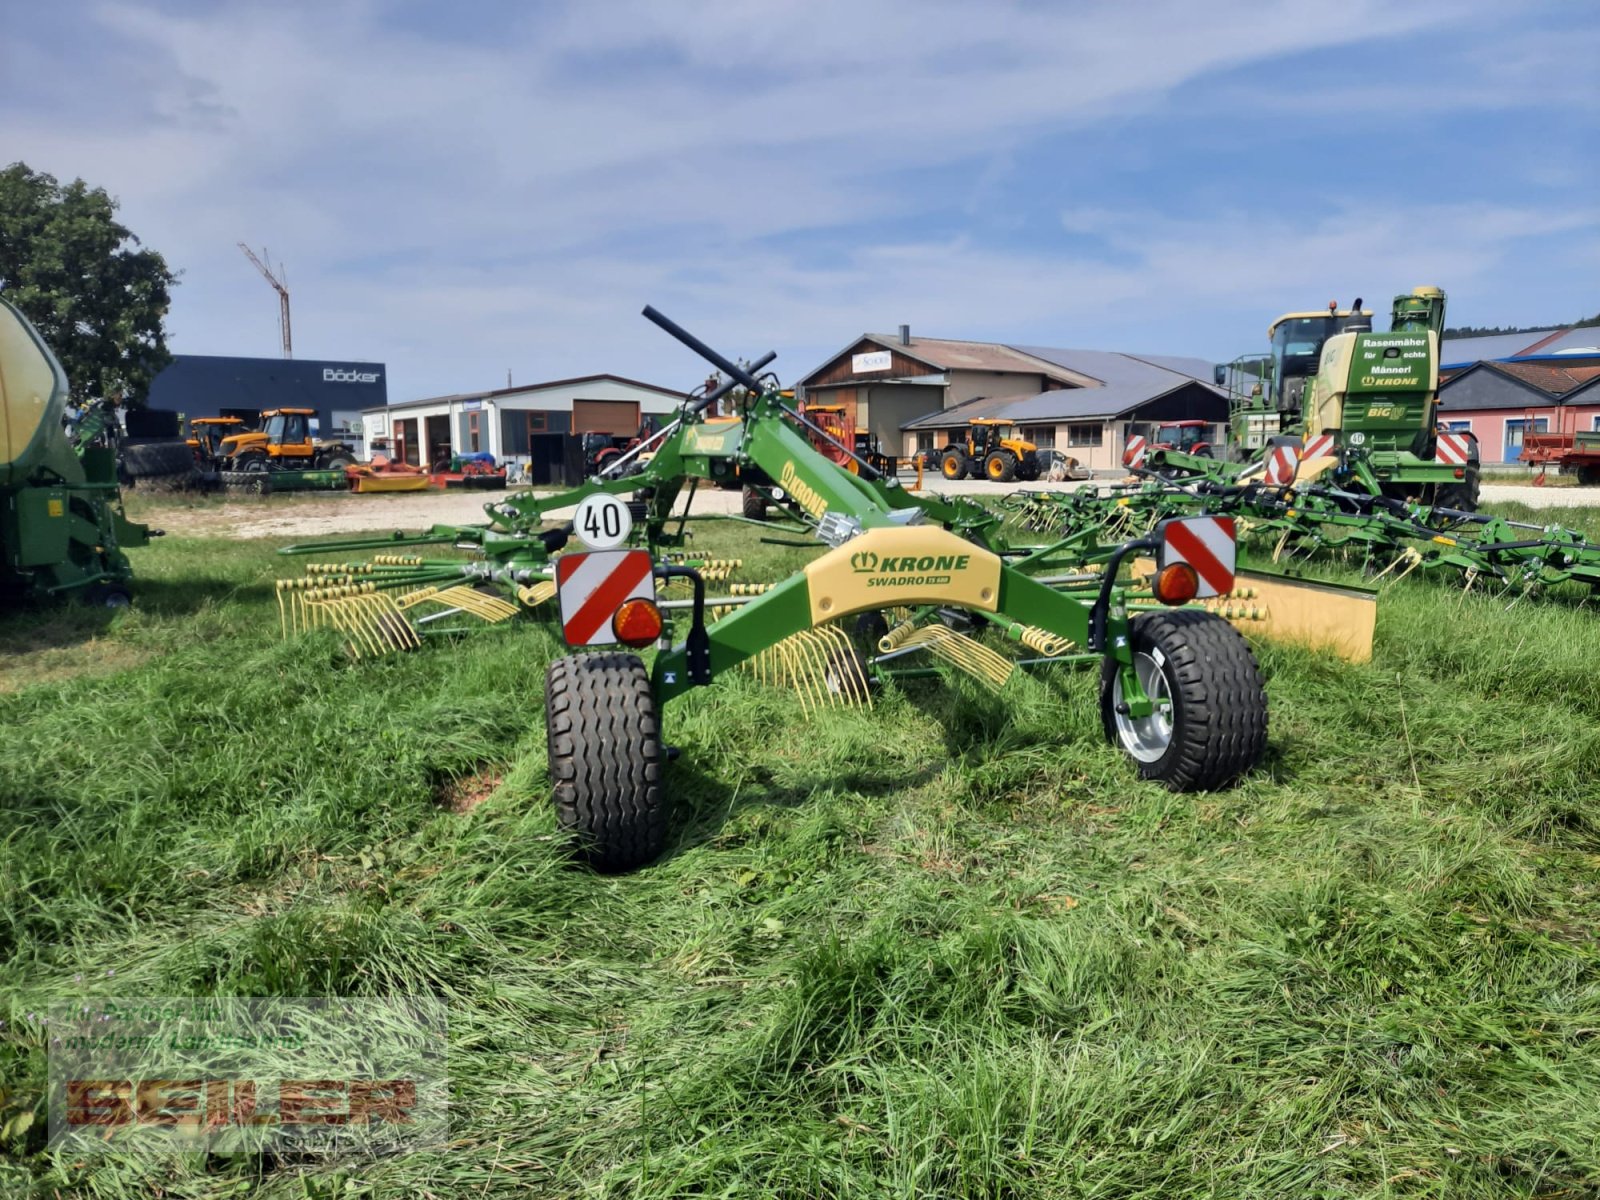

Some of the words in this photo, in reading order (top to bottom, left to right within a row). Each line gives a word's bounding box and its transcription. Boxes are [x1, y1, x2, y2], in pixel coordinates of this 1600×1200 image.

[1363, 338, 1426, 347] Rasenmäher
[323, 368, 380, 382] Böcker
[1375, 378, 1418, 386] KRONE
[1353, 434, 1363, 443] 40
[788, 474, 829, 520] KRONE
[584, 503, 620, 538] 40
[880, 555, 970, 572] KRONE
[867, 576, 924, 587] SWADRO
